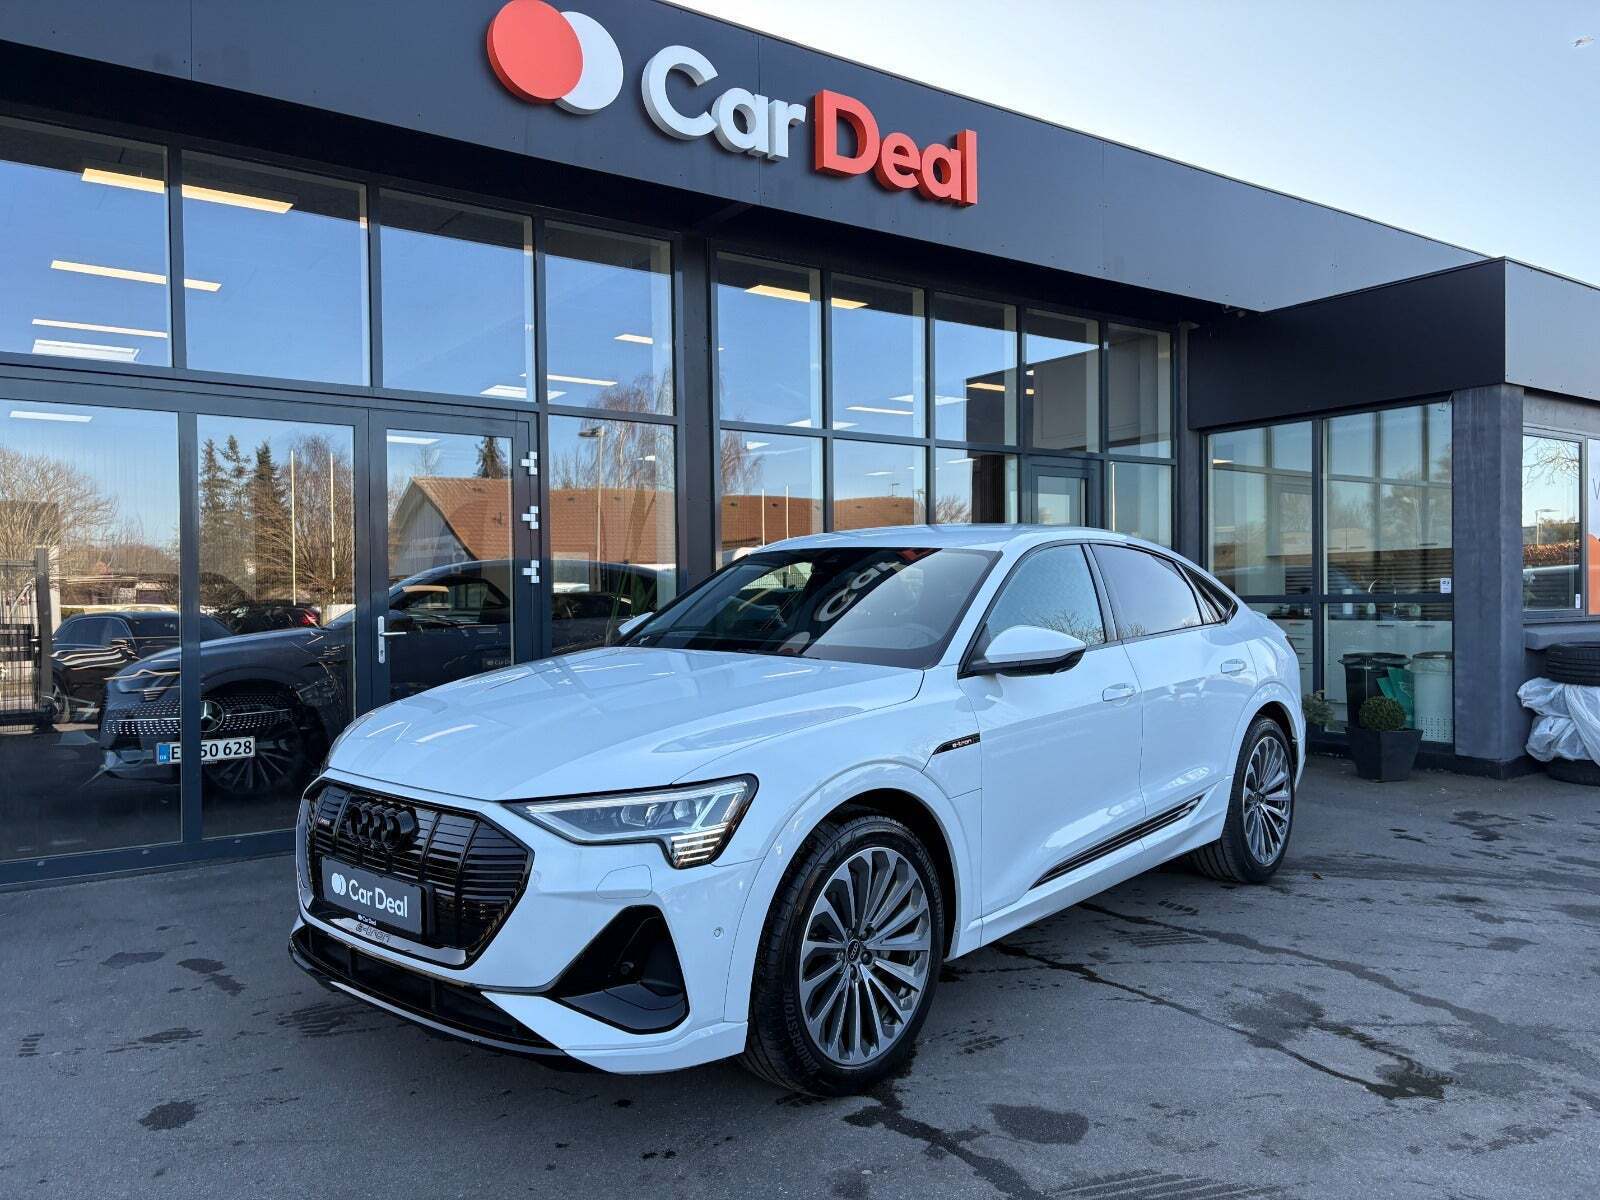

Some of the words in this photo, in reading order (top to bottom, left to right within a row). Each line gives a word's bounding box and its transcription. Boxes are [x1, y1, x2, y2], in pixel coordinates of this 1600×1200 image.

[641, 45, 807, 162] Car
[815, 89, 978, 206] Deal
[223, 741, 252, 756] 628
[348, 879, 372, 906] Car
[375, 887, 408, 918] Deal
